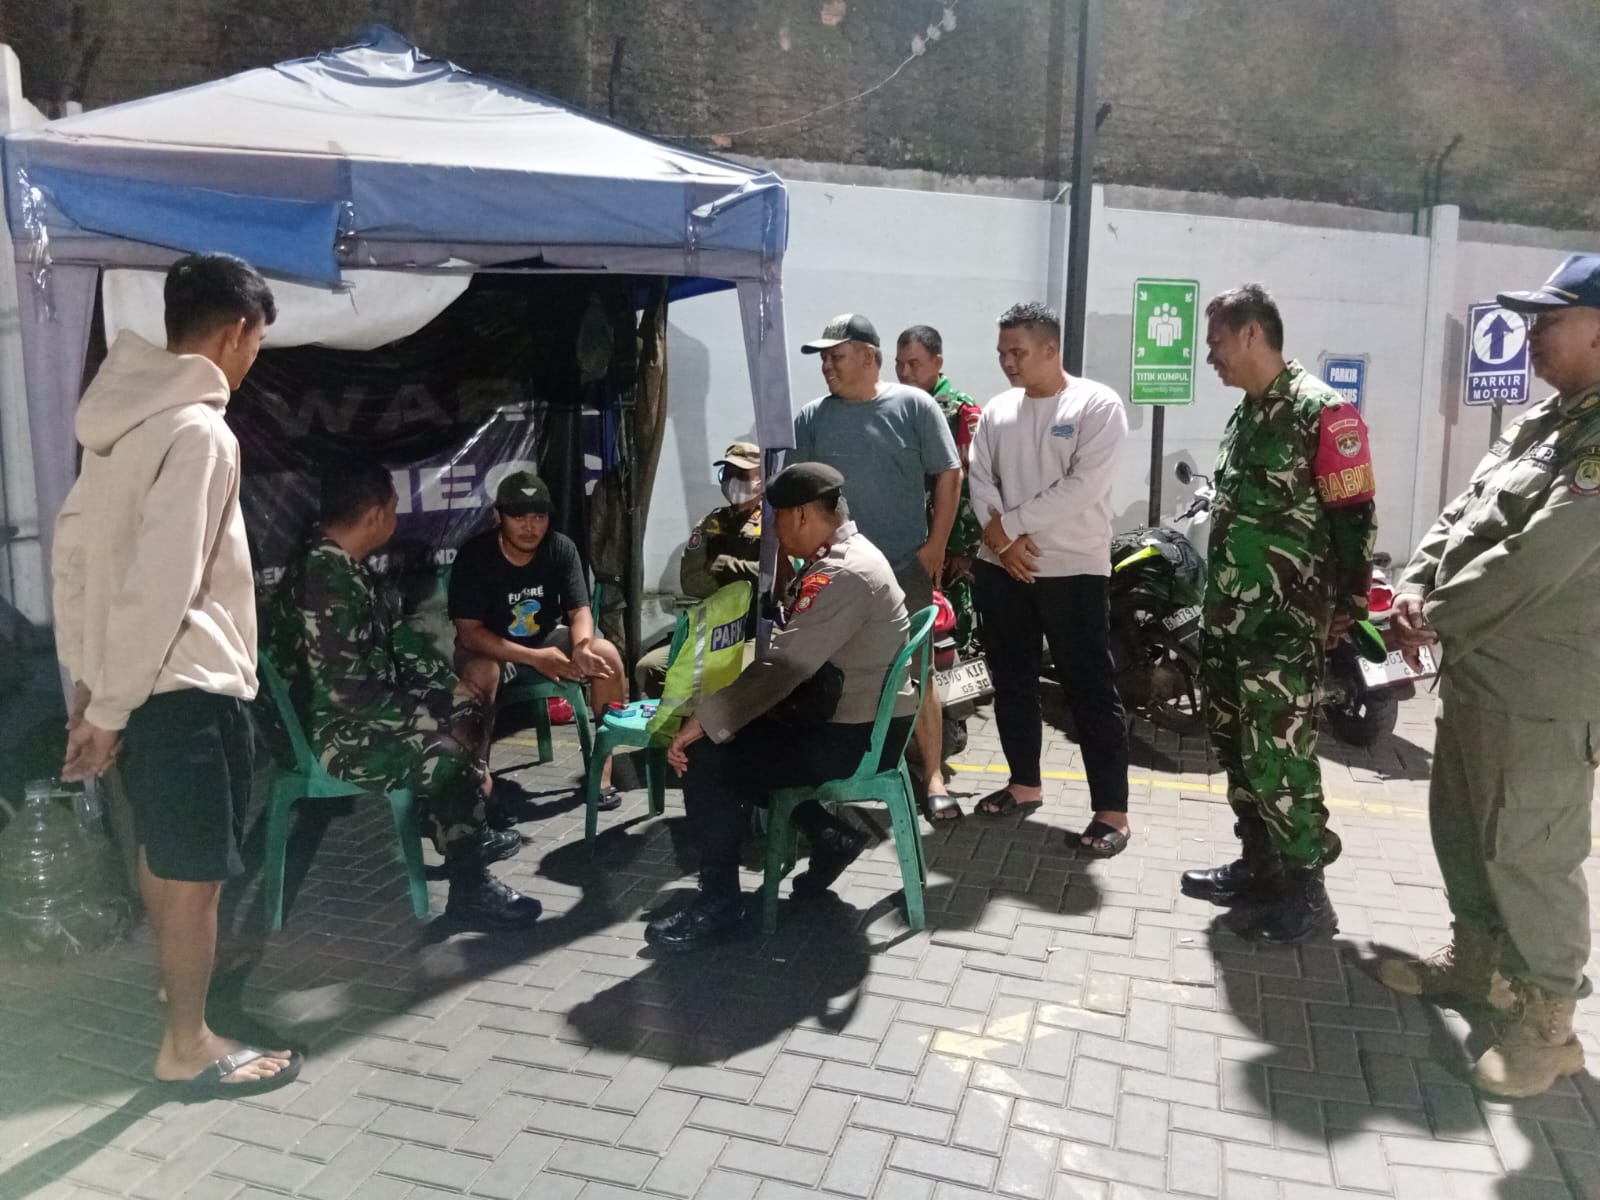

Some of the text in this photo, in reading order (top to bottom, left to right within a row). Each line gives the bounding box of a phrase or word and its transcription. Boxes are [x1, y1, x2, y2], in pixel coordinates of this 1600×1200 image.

[1136, 372, 1189, 381] TITIK KUMPUL
[1330, 367, 1358, 383] PARKIR
[1472, 375, 1521, 387] PARKIR
[1473, 387, 1518, 399] MOTOR
